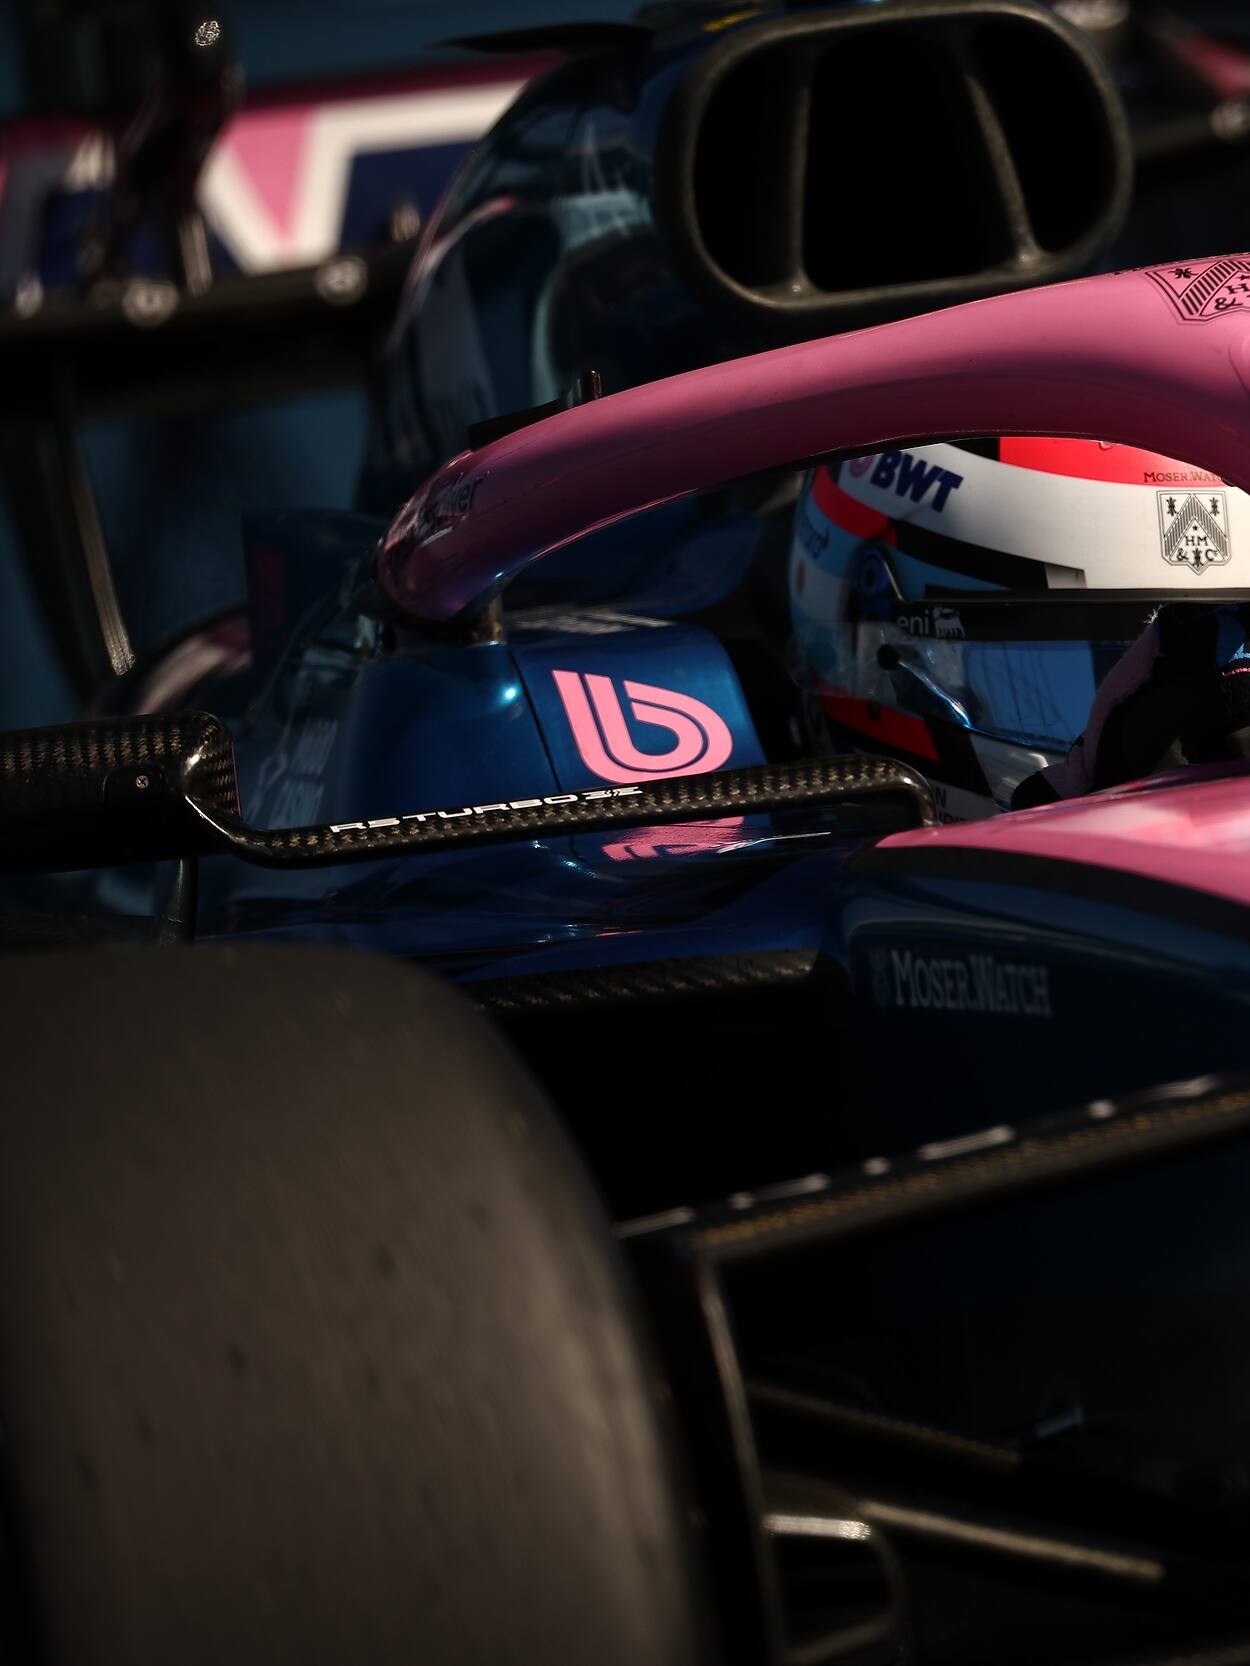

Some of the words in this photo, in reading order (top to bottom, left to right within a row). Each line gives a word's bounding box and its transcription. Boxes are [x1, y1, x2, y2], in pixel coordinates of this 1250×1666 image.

[1214, 296, 1243, 311] &
[870, 449, 963, 512] BWT
[1185, 536, 1208, 546] HM
[896, 608, 930, 636] eni
